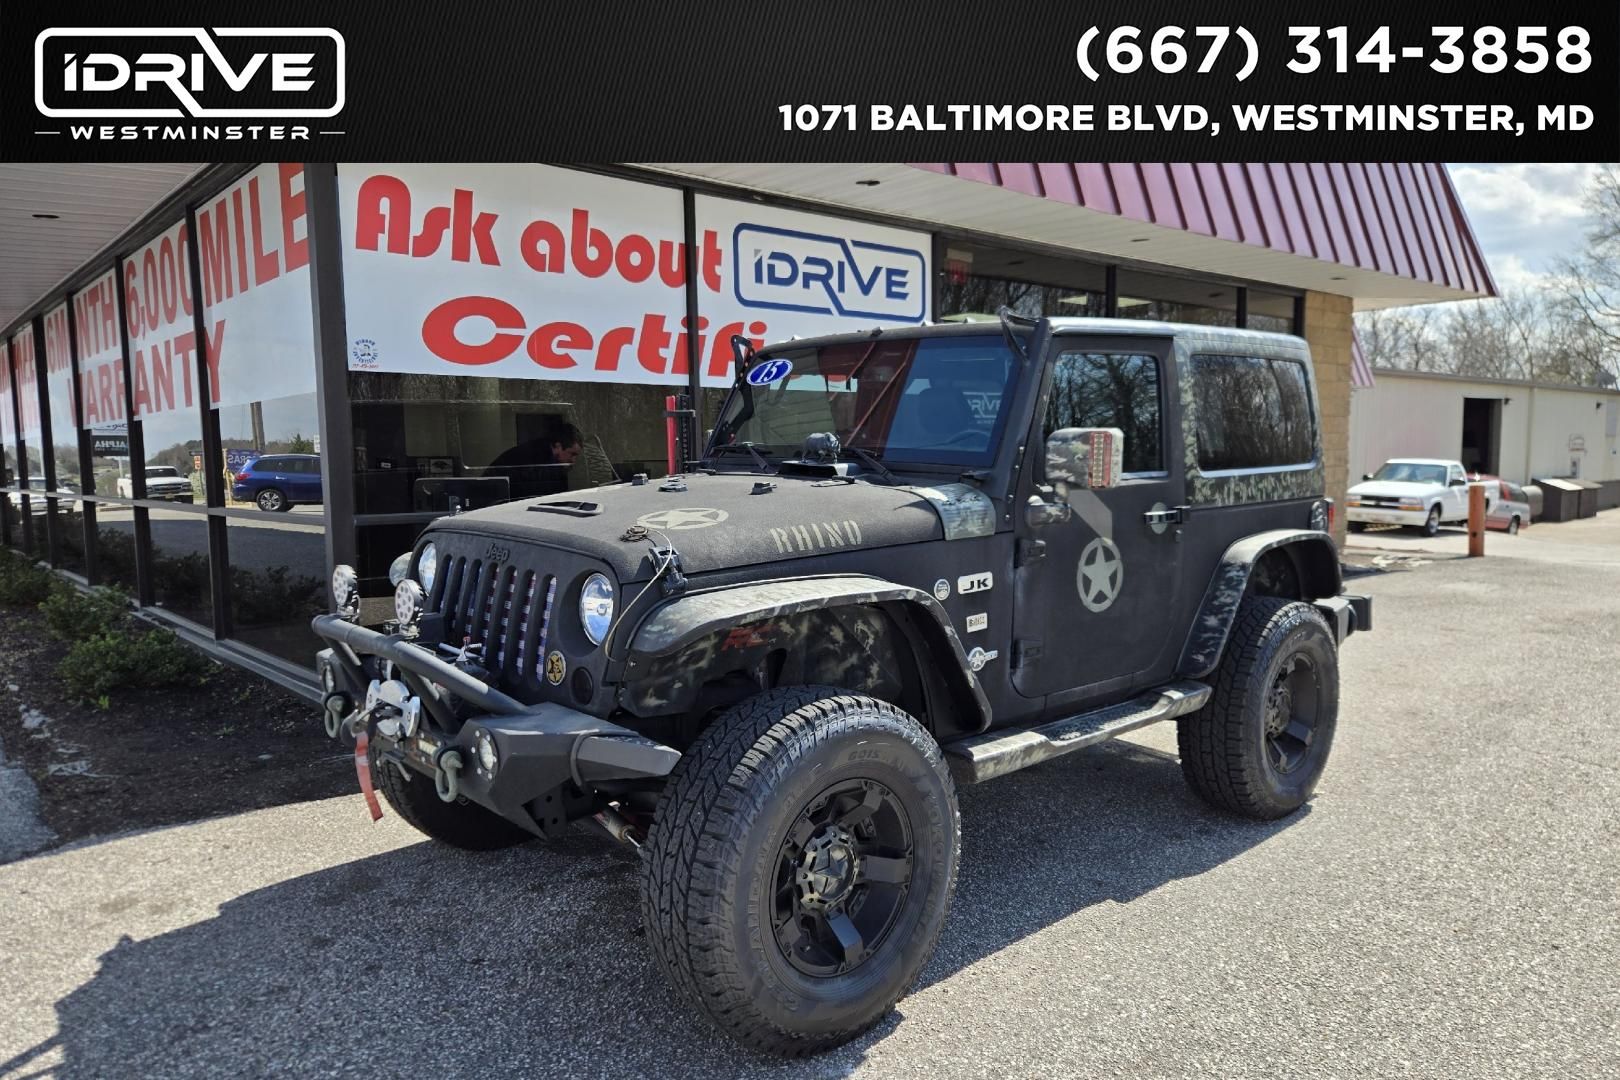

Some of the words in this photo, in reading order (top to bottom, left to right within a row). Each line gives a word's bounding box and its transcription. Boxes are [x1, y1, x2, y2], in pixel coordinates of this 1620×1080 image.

[199, 163, 310, 308] MILE
[355, 174, 500, 266] Ask
[519, 208, 722, 293] about
[421, 295, 768, 378] Certifi
[66, 320, 226, 428] ARRANTY
[755, 361, 784, 383] 15
[486, 543, 510, 565] Jeep
[770, 519, 862, 554] RHINO
[963, 578, 989, 592] JK
